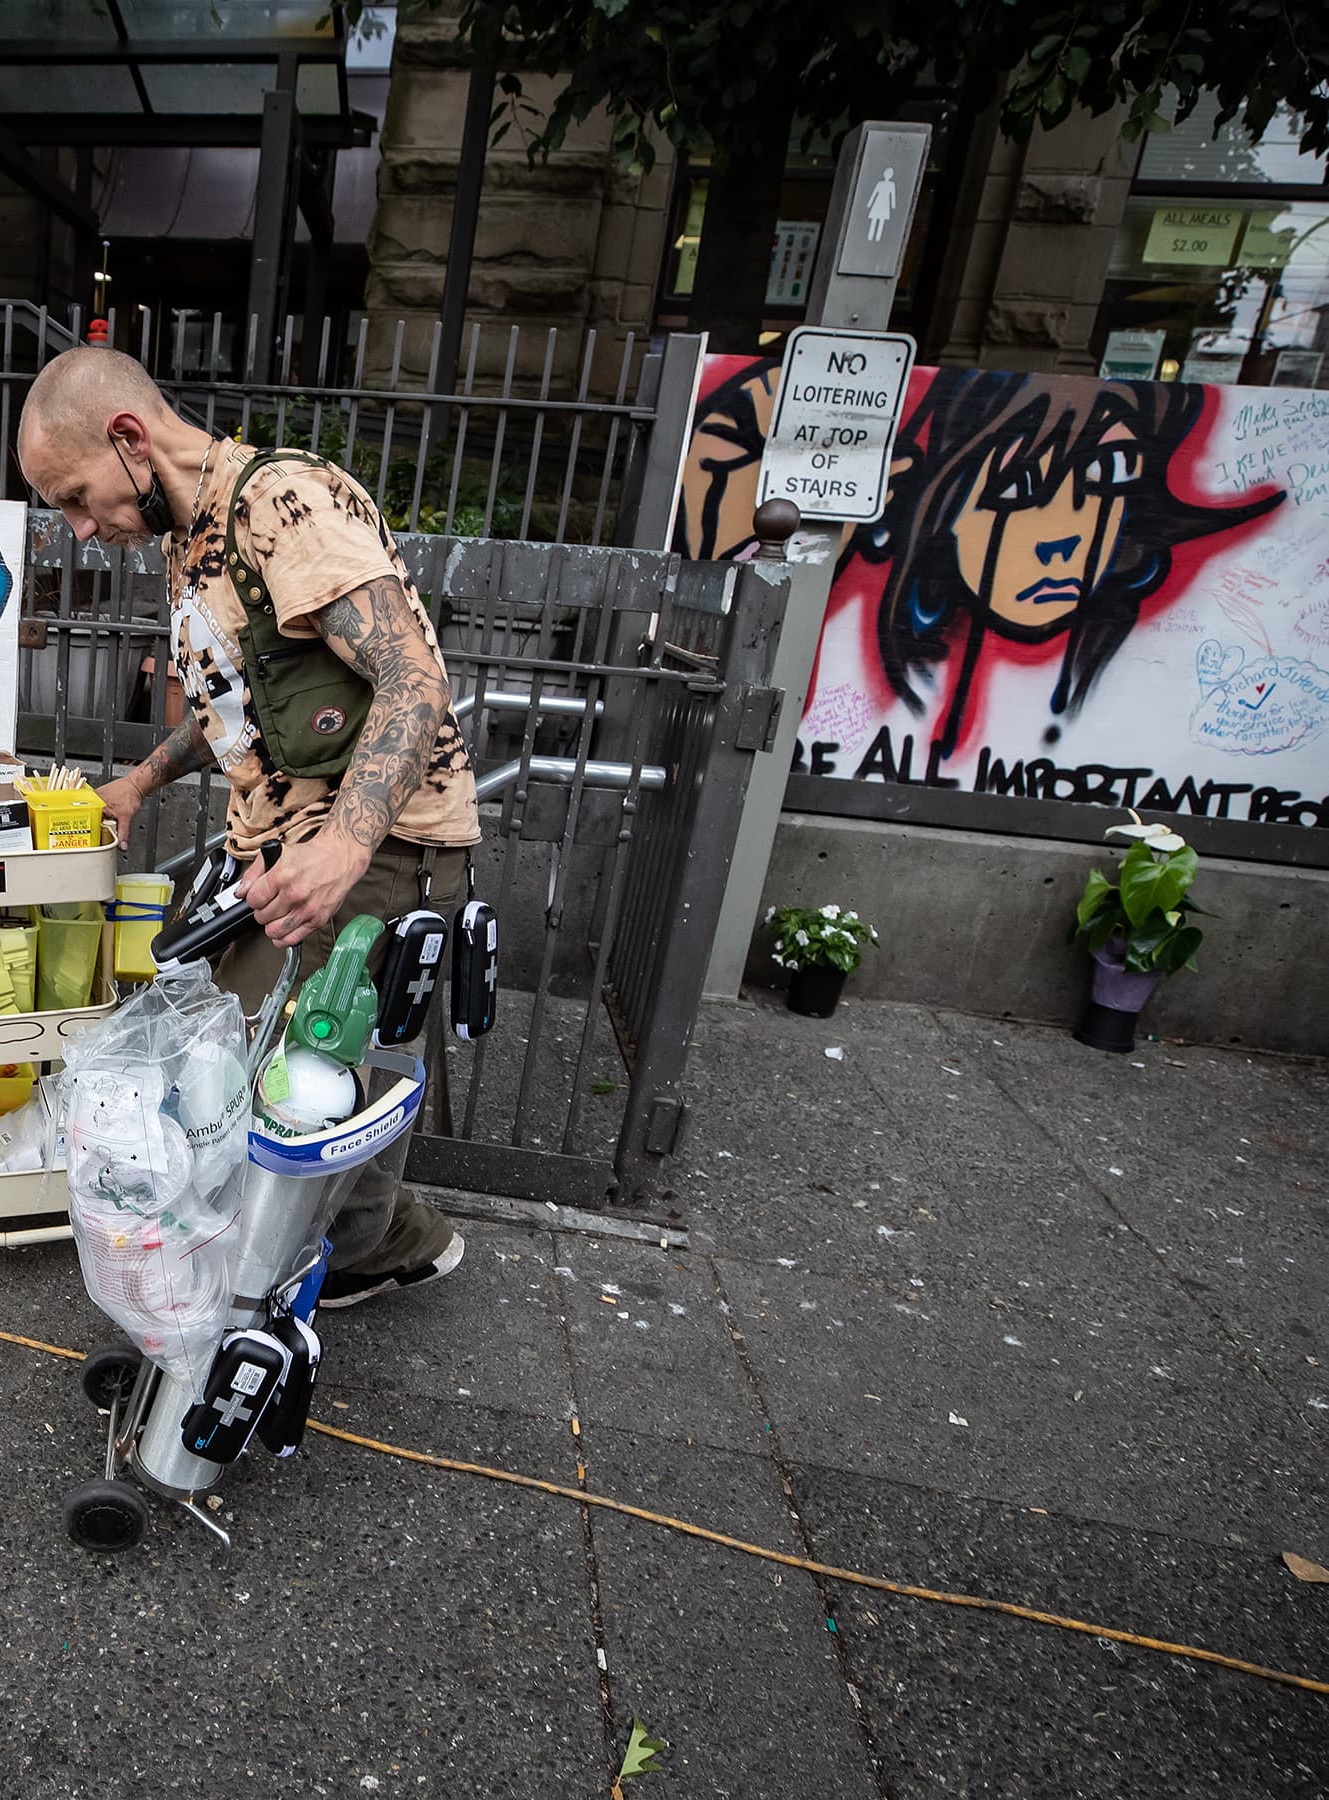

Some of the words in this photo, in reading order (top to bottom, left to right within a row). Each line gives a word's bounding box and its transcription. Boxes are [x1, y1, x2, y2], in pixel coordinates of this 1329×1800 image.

[1162, 211, 1186, 226] ALL
[1188, 212, 1231, 226] MEALS
[1172, 238, 1209, 253] $2.00
[826, 350, 868, 376] NO
[792, 384, 889, 410] LOITERING
[794, 424, 821, 444] AT
[829, 426, 869, 447] TOP
[811, 452, 840, 472] OF
[785, 476, 859, 500] STAIRS
[229, 720, 257, 767] LIVES
[854, 725, 960, 789] ALL
[974, 745, 1254, 819] IMPORTANT
[1248, 786, 1329, 829] PEO
[185, 1119, 223, 1140] Ambu
[329, 1137, 363, 1157] Face
[364, 1112, 401, 1142] Shield
